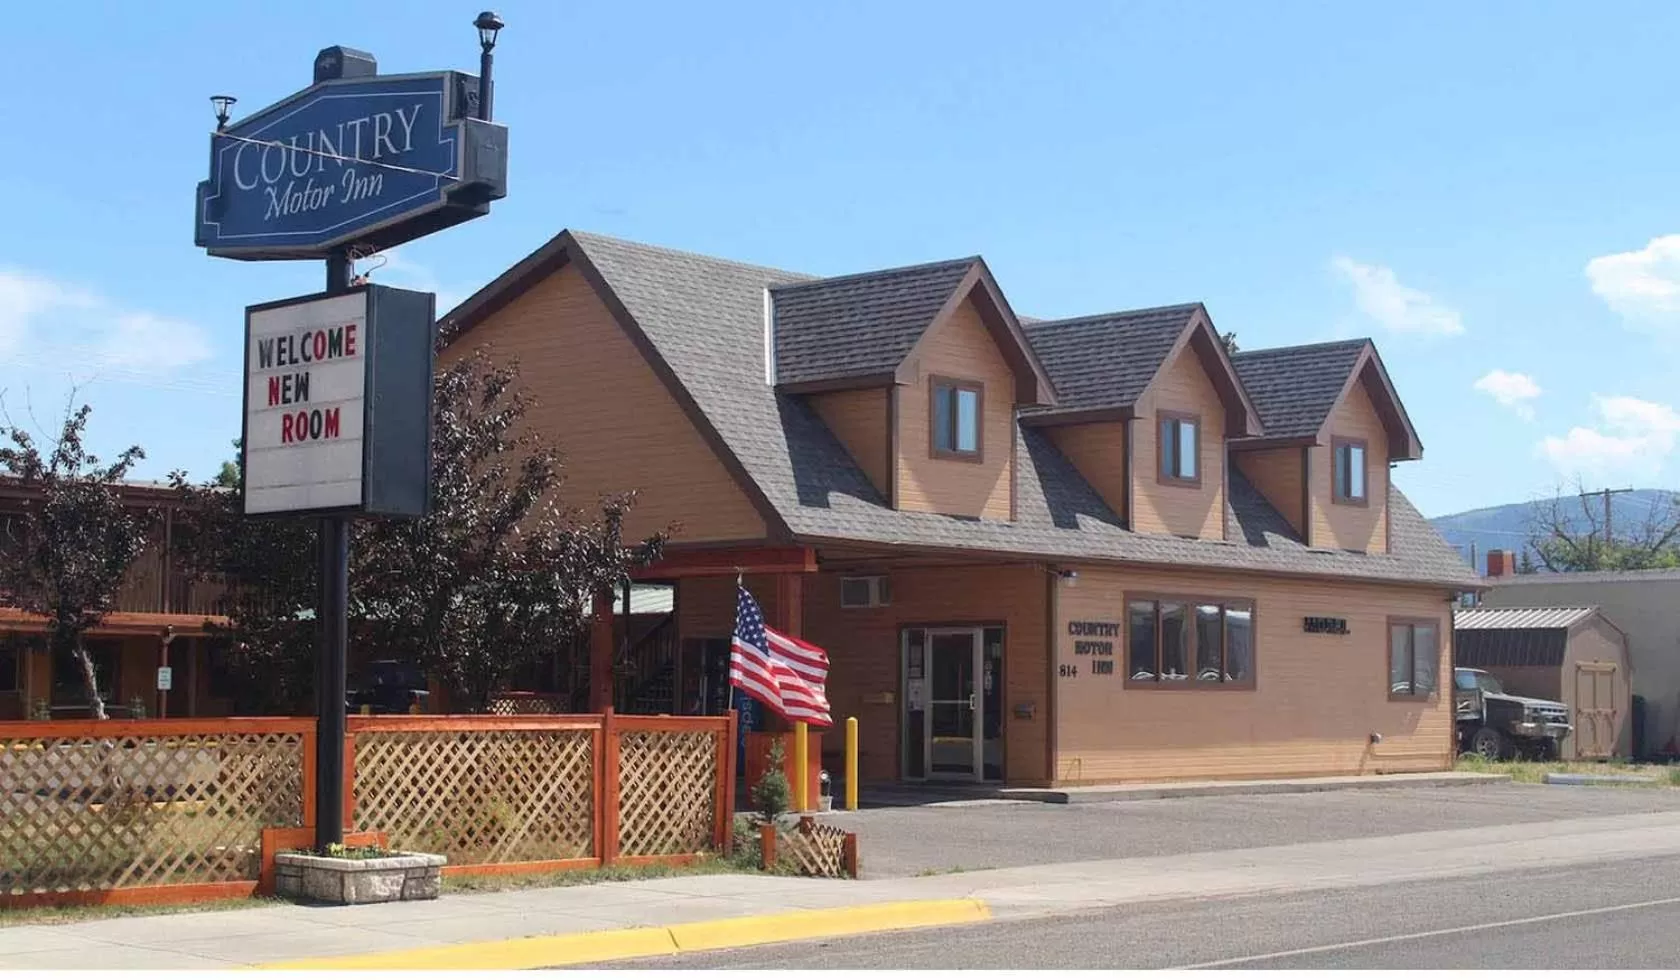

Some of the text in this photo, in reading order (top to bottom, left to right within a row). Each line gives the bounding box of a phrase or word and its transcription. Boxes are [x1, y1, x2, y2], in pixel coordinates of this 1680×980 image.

[234, 103, 423, 190] COUNTRY
[264, 168, 384, 221] Motor Inn
[258, 324, 357, 369] WELCOME
[268, 372, 310, 406] NEW
[281, 407, 340, 443] ROOM
[1059, 664, 1078, 678] 814
